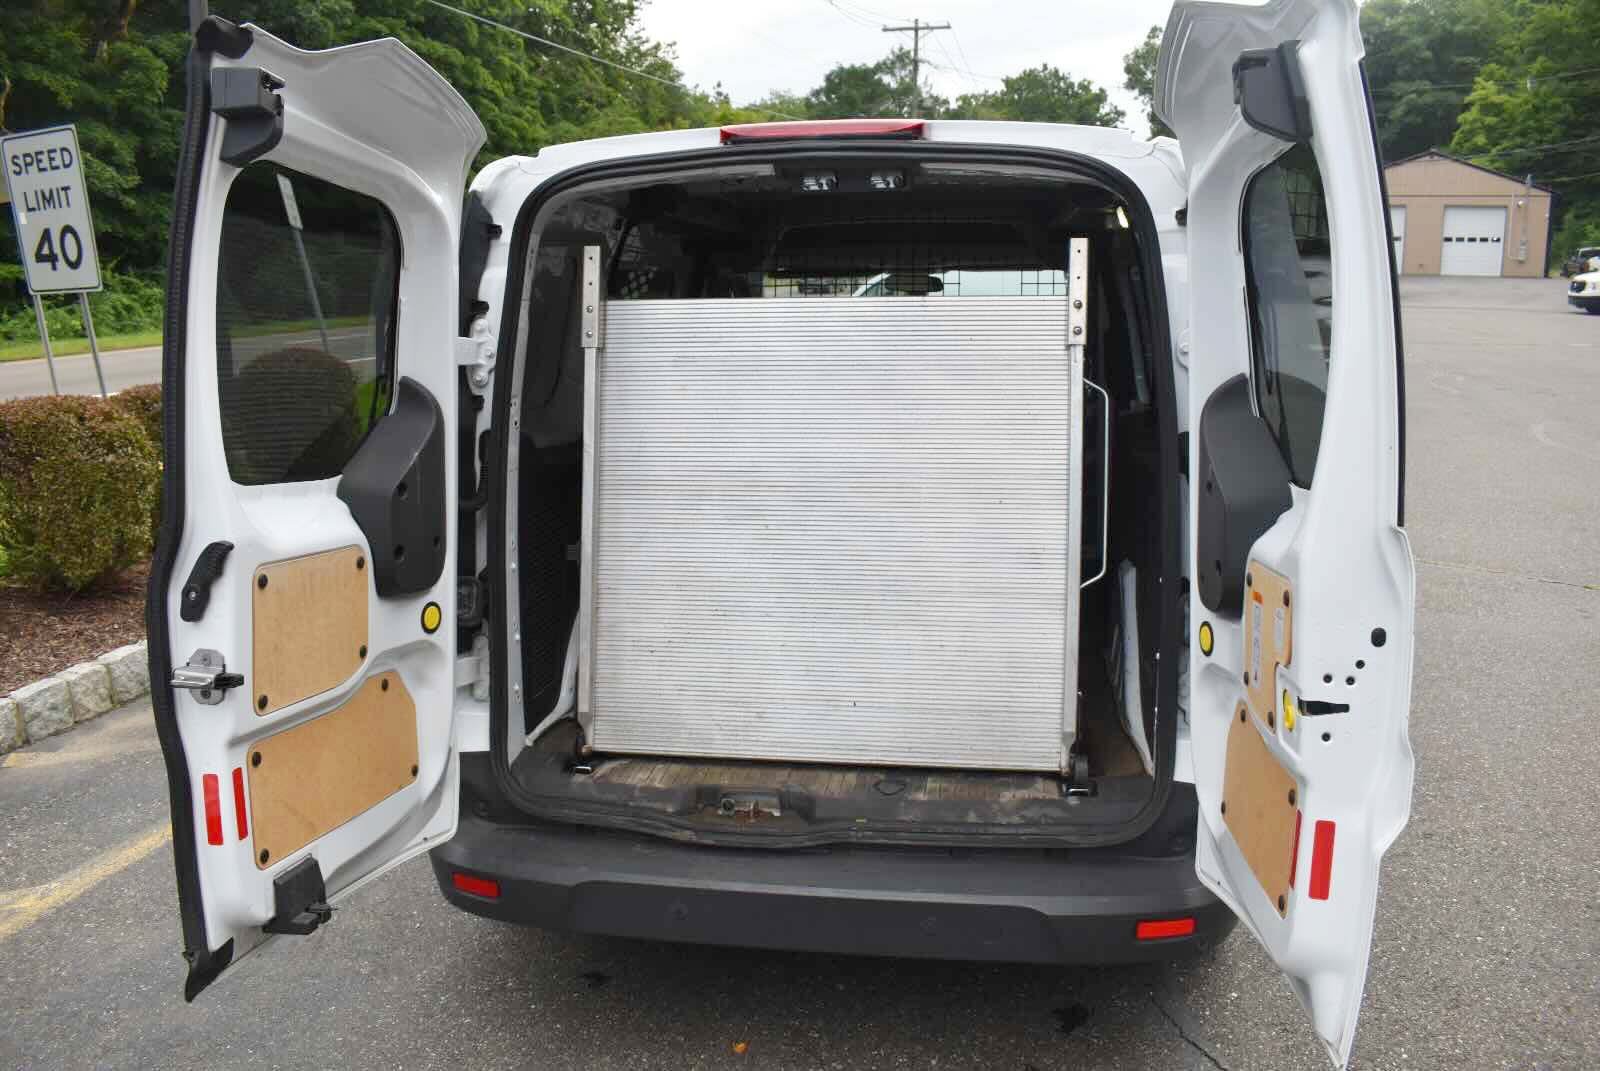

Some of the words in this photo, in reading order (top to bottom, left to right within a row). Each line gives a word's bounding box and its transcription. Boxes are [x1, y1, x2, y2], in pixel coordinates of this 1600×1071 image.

[11, 147, 73, 175] SPEED
[24, 186, 71, 211] LIMIT
[35, 224, 82, 270] 40
